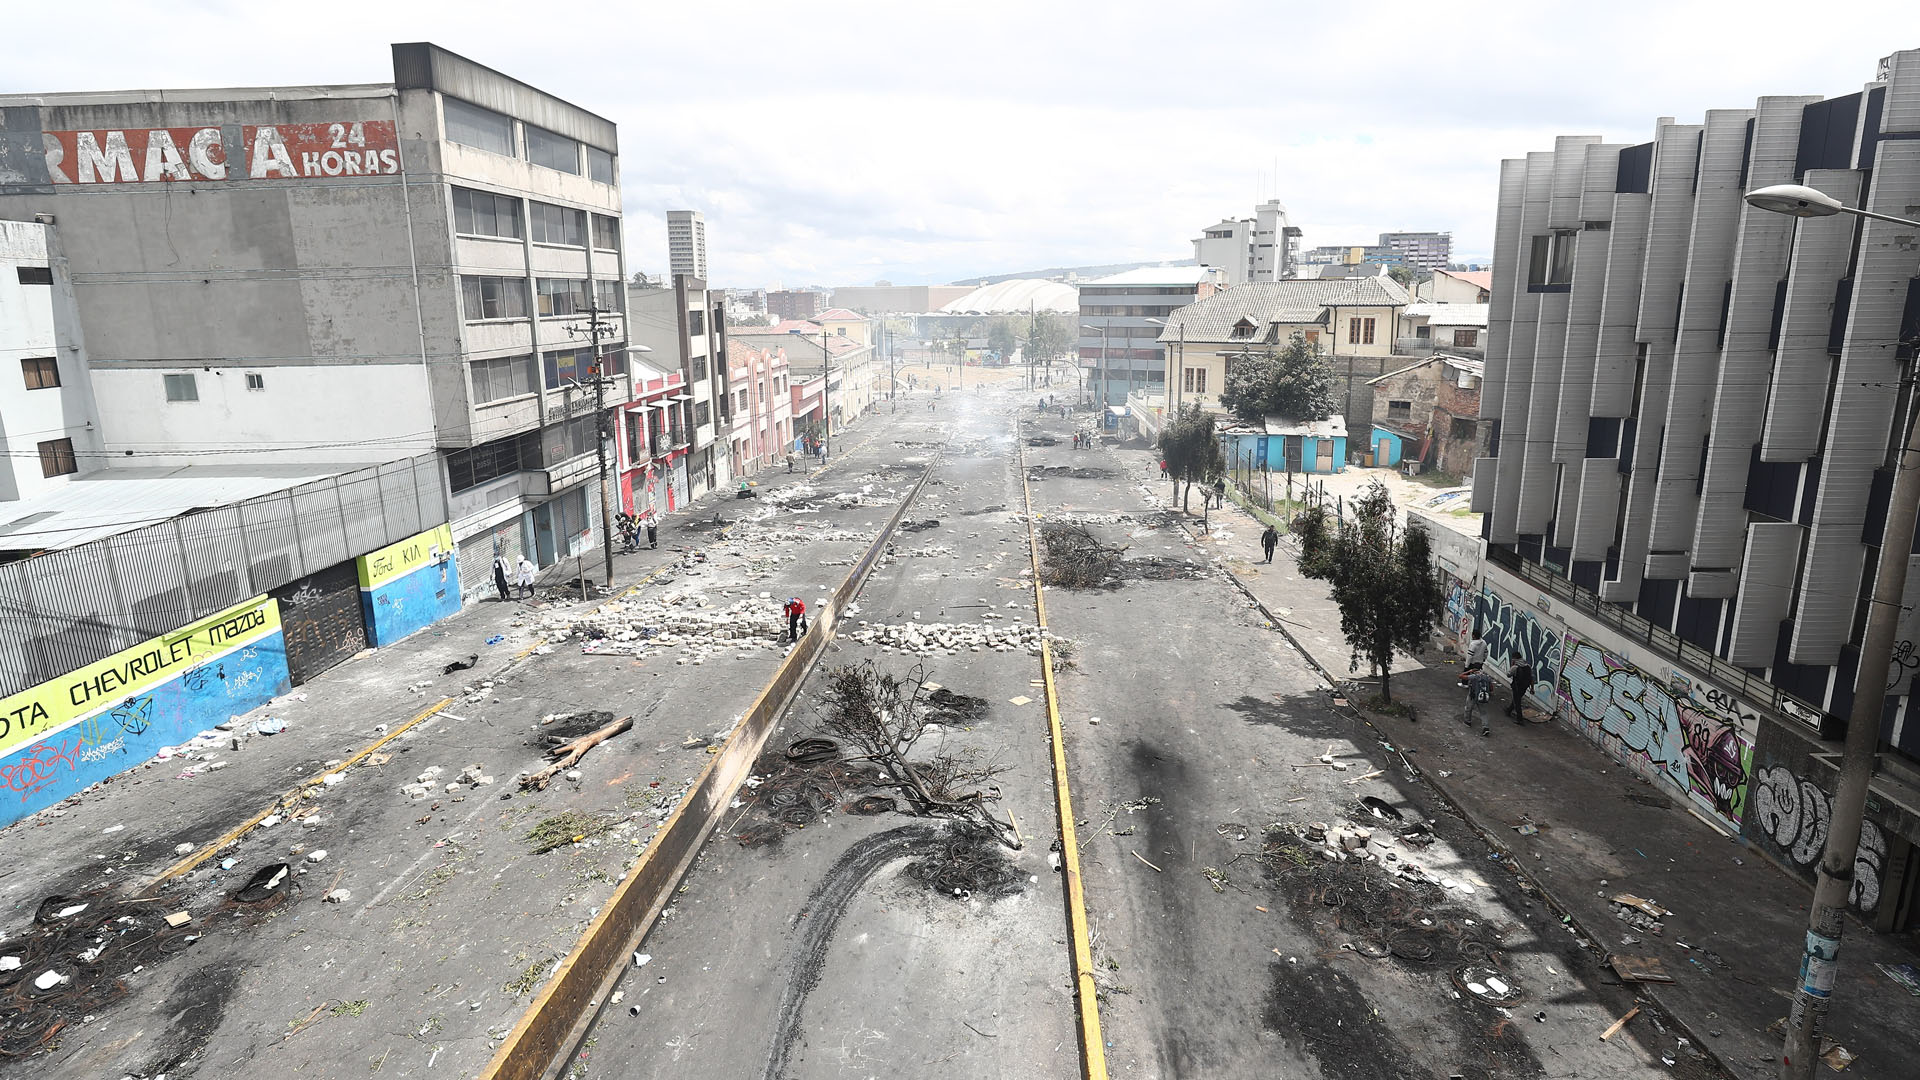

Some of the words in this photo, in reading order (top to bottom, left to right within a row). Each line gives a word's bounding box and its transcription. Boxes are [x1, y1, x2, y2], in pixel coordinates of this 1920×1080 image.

[328, 122, 366, 149] 24
[301, 150, 398, 176] HORAS
[373, 555, 394, 578] Ford
[402, 544, 421, 565] KIA
[69, 635, 194, 706] CHEVROLET
